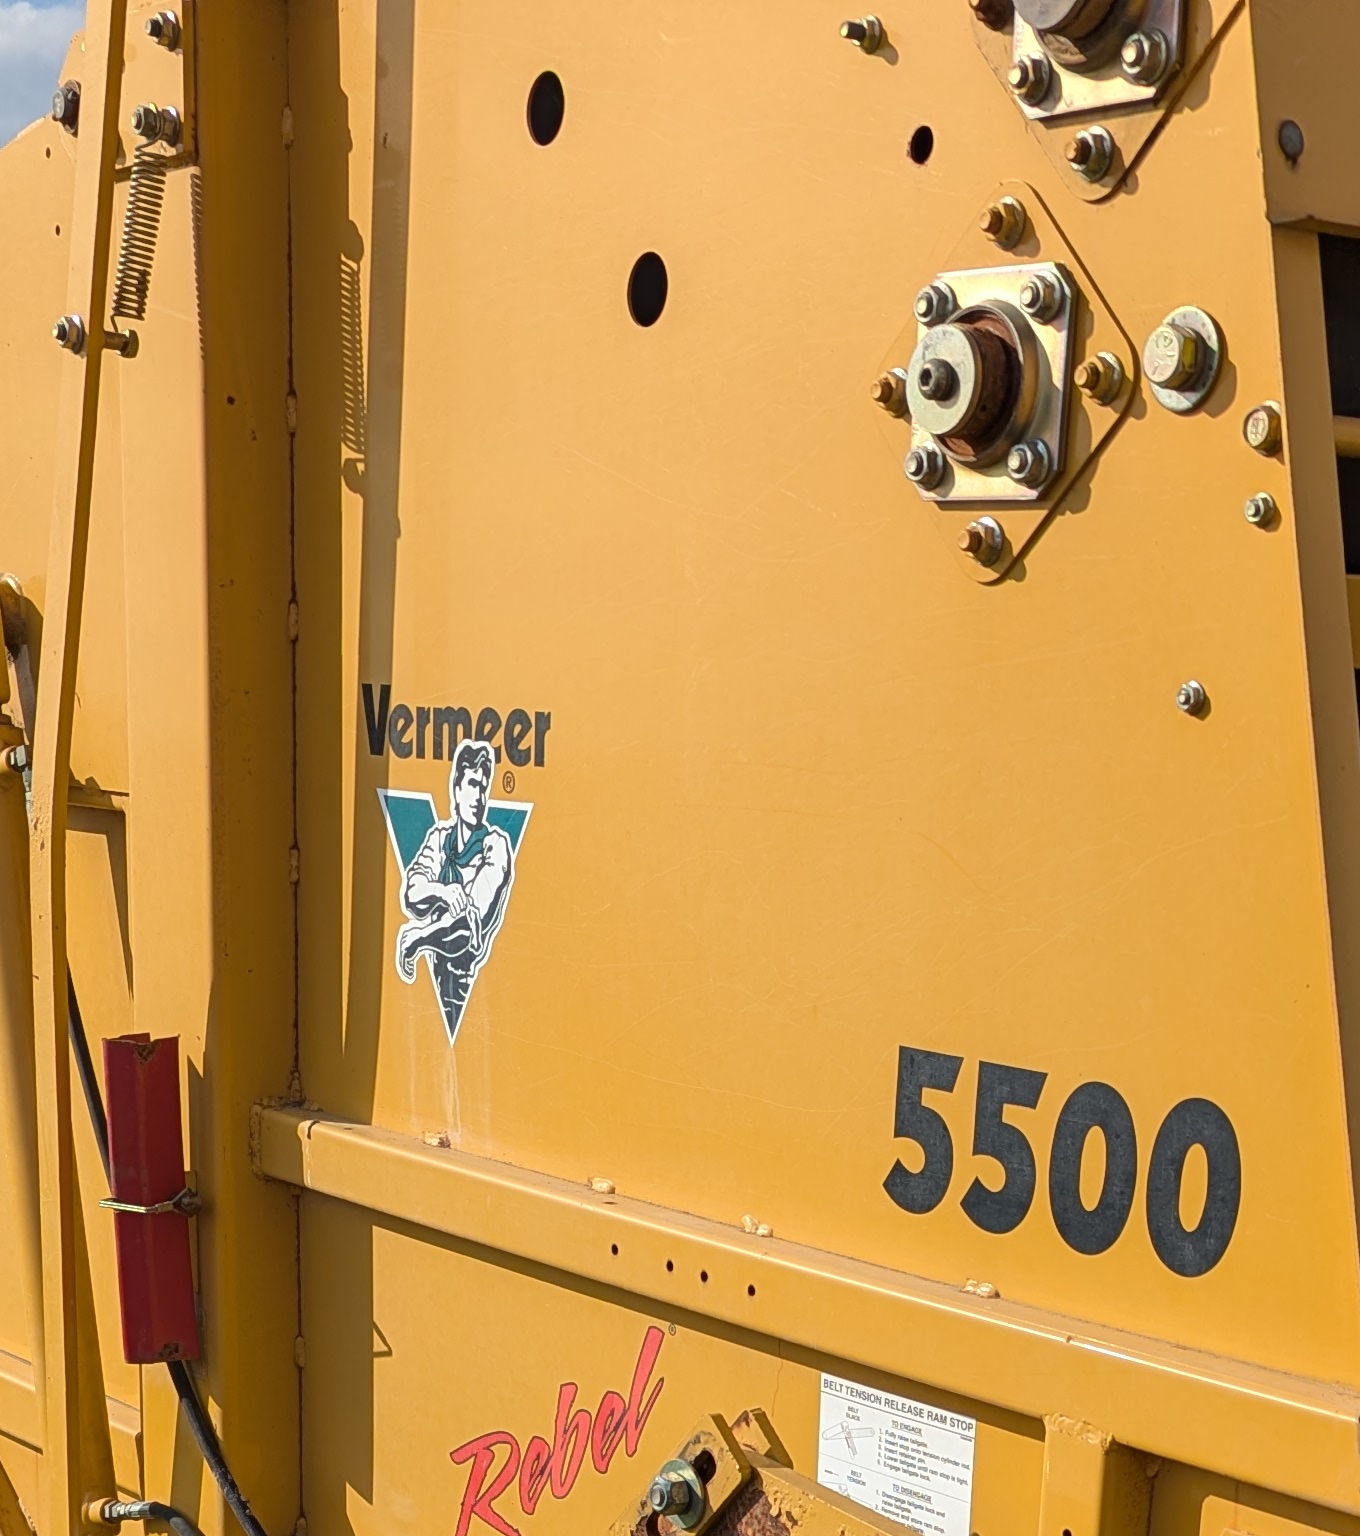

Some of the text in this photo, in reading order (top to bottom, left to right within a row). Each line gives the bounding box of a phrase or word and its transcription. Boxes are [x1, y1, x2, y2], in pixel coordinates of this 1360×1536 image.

[361, 683, 551, 767] Vermeer
[882, 1045, 1241, 1277] 5500
[823, 1379, 973, 1432] BELT TENSION RELEASE RAM STOP
